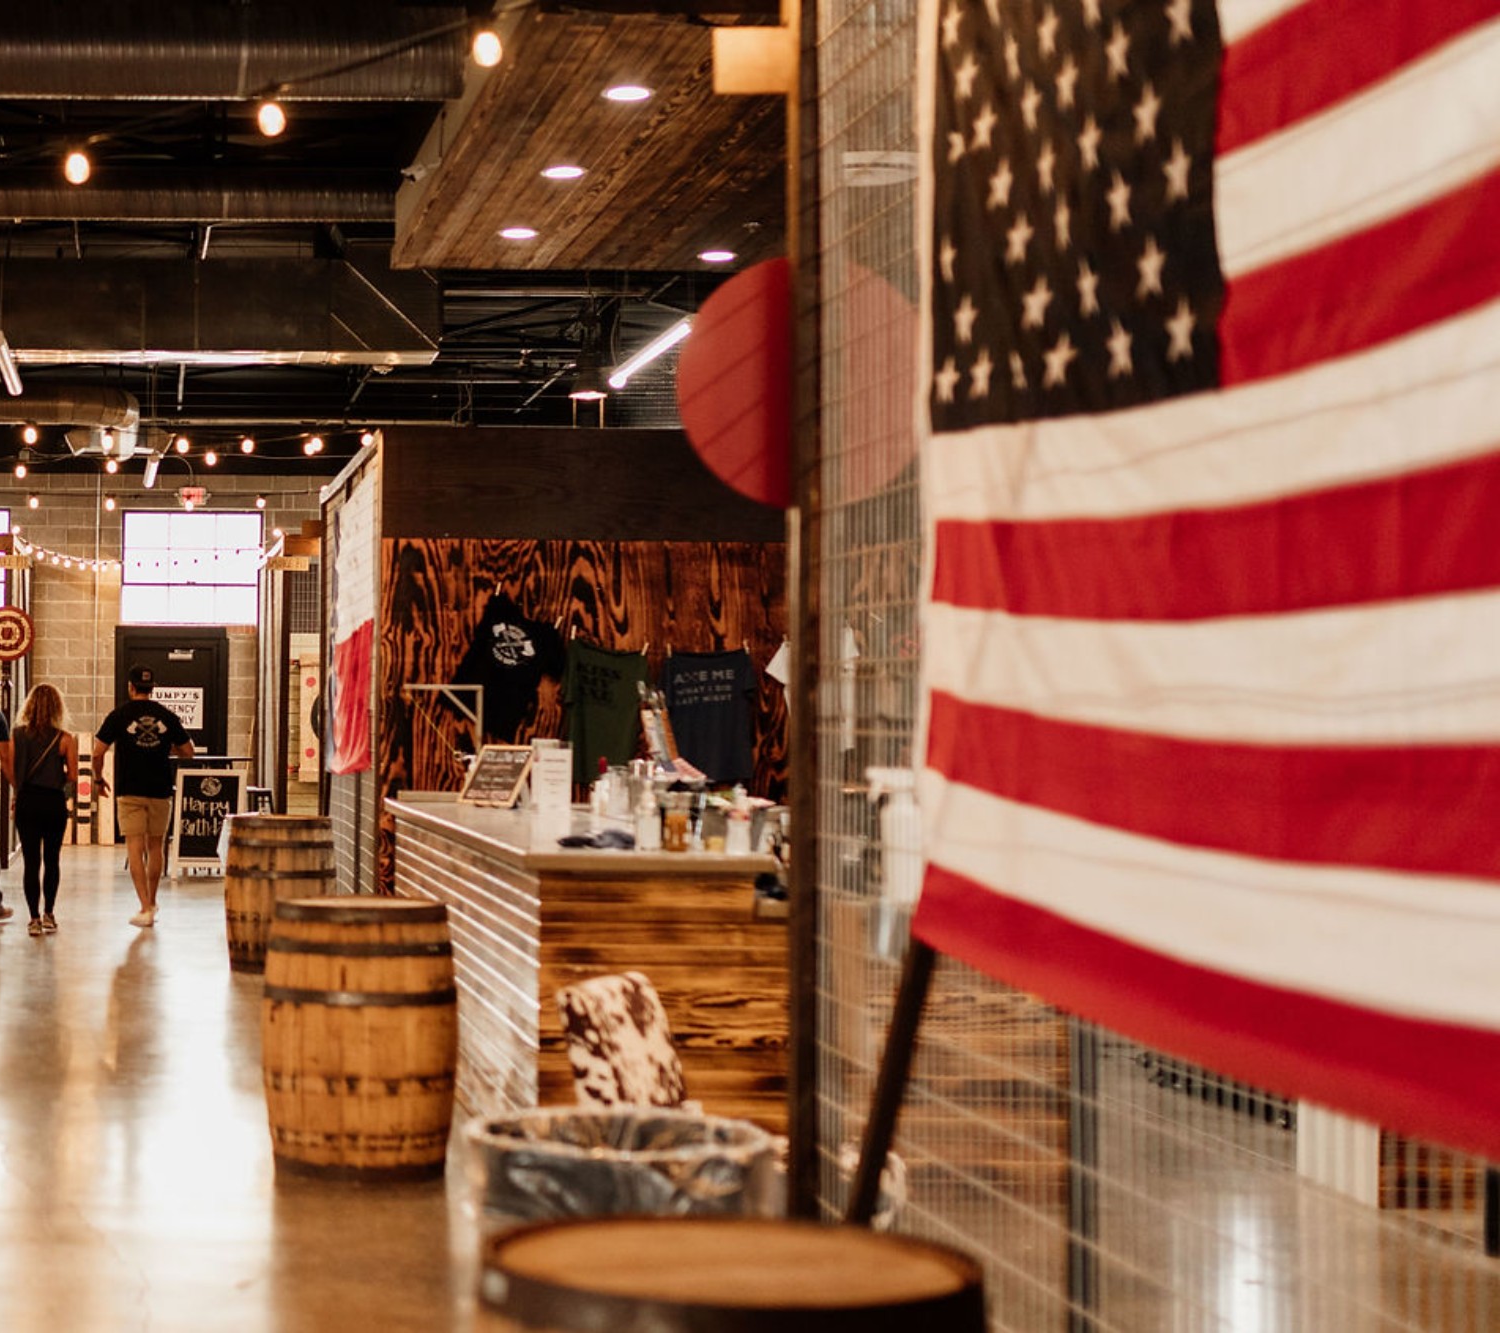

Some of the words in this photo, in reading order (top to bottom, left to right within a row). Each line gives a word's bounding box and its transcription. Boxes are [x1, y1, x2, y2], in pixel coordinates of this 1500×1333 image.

[711, 669, 735, 681] ME
[149, 691, 199, 700] TUMPY'S
[183, 797, 229, 817] Happy
